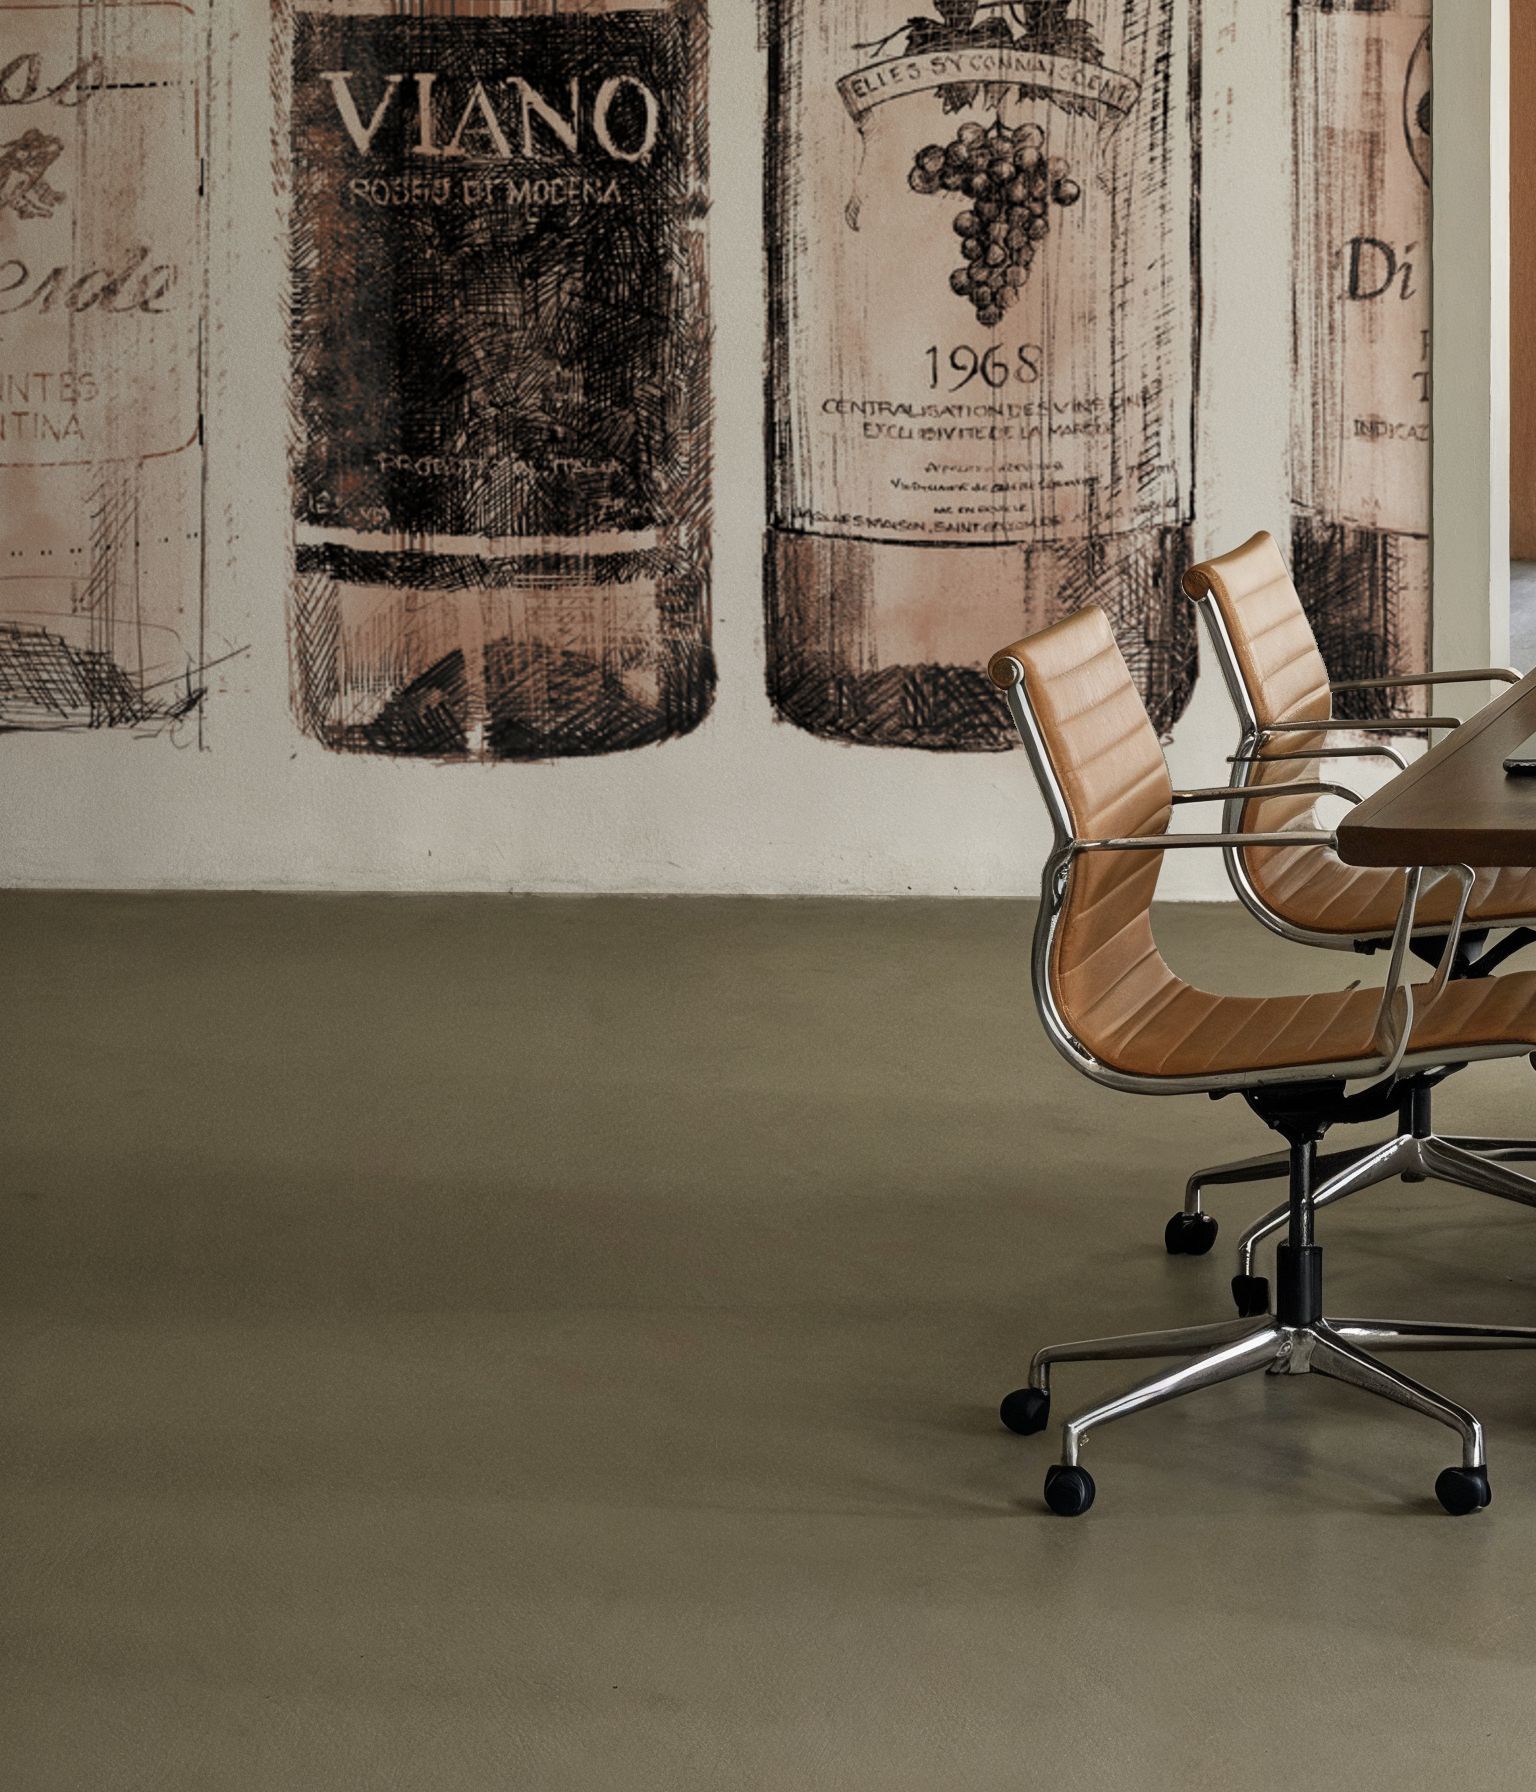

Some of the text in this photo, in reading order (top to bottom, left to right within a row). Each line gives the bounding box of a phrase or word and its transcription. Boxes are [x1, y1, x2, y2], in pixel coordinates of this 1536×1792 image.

[319, 70, 659, 164] VIANO
[0, 371, 99, 404] NTES
[925, 344, 1042, 392] 1968
